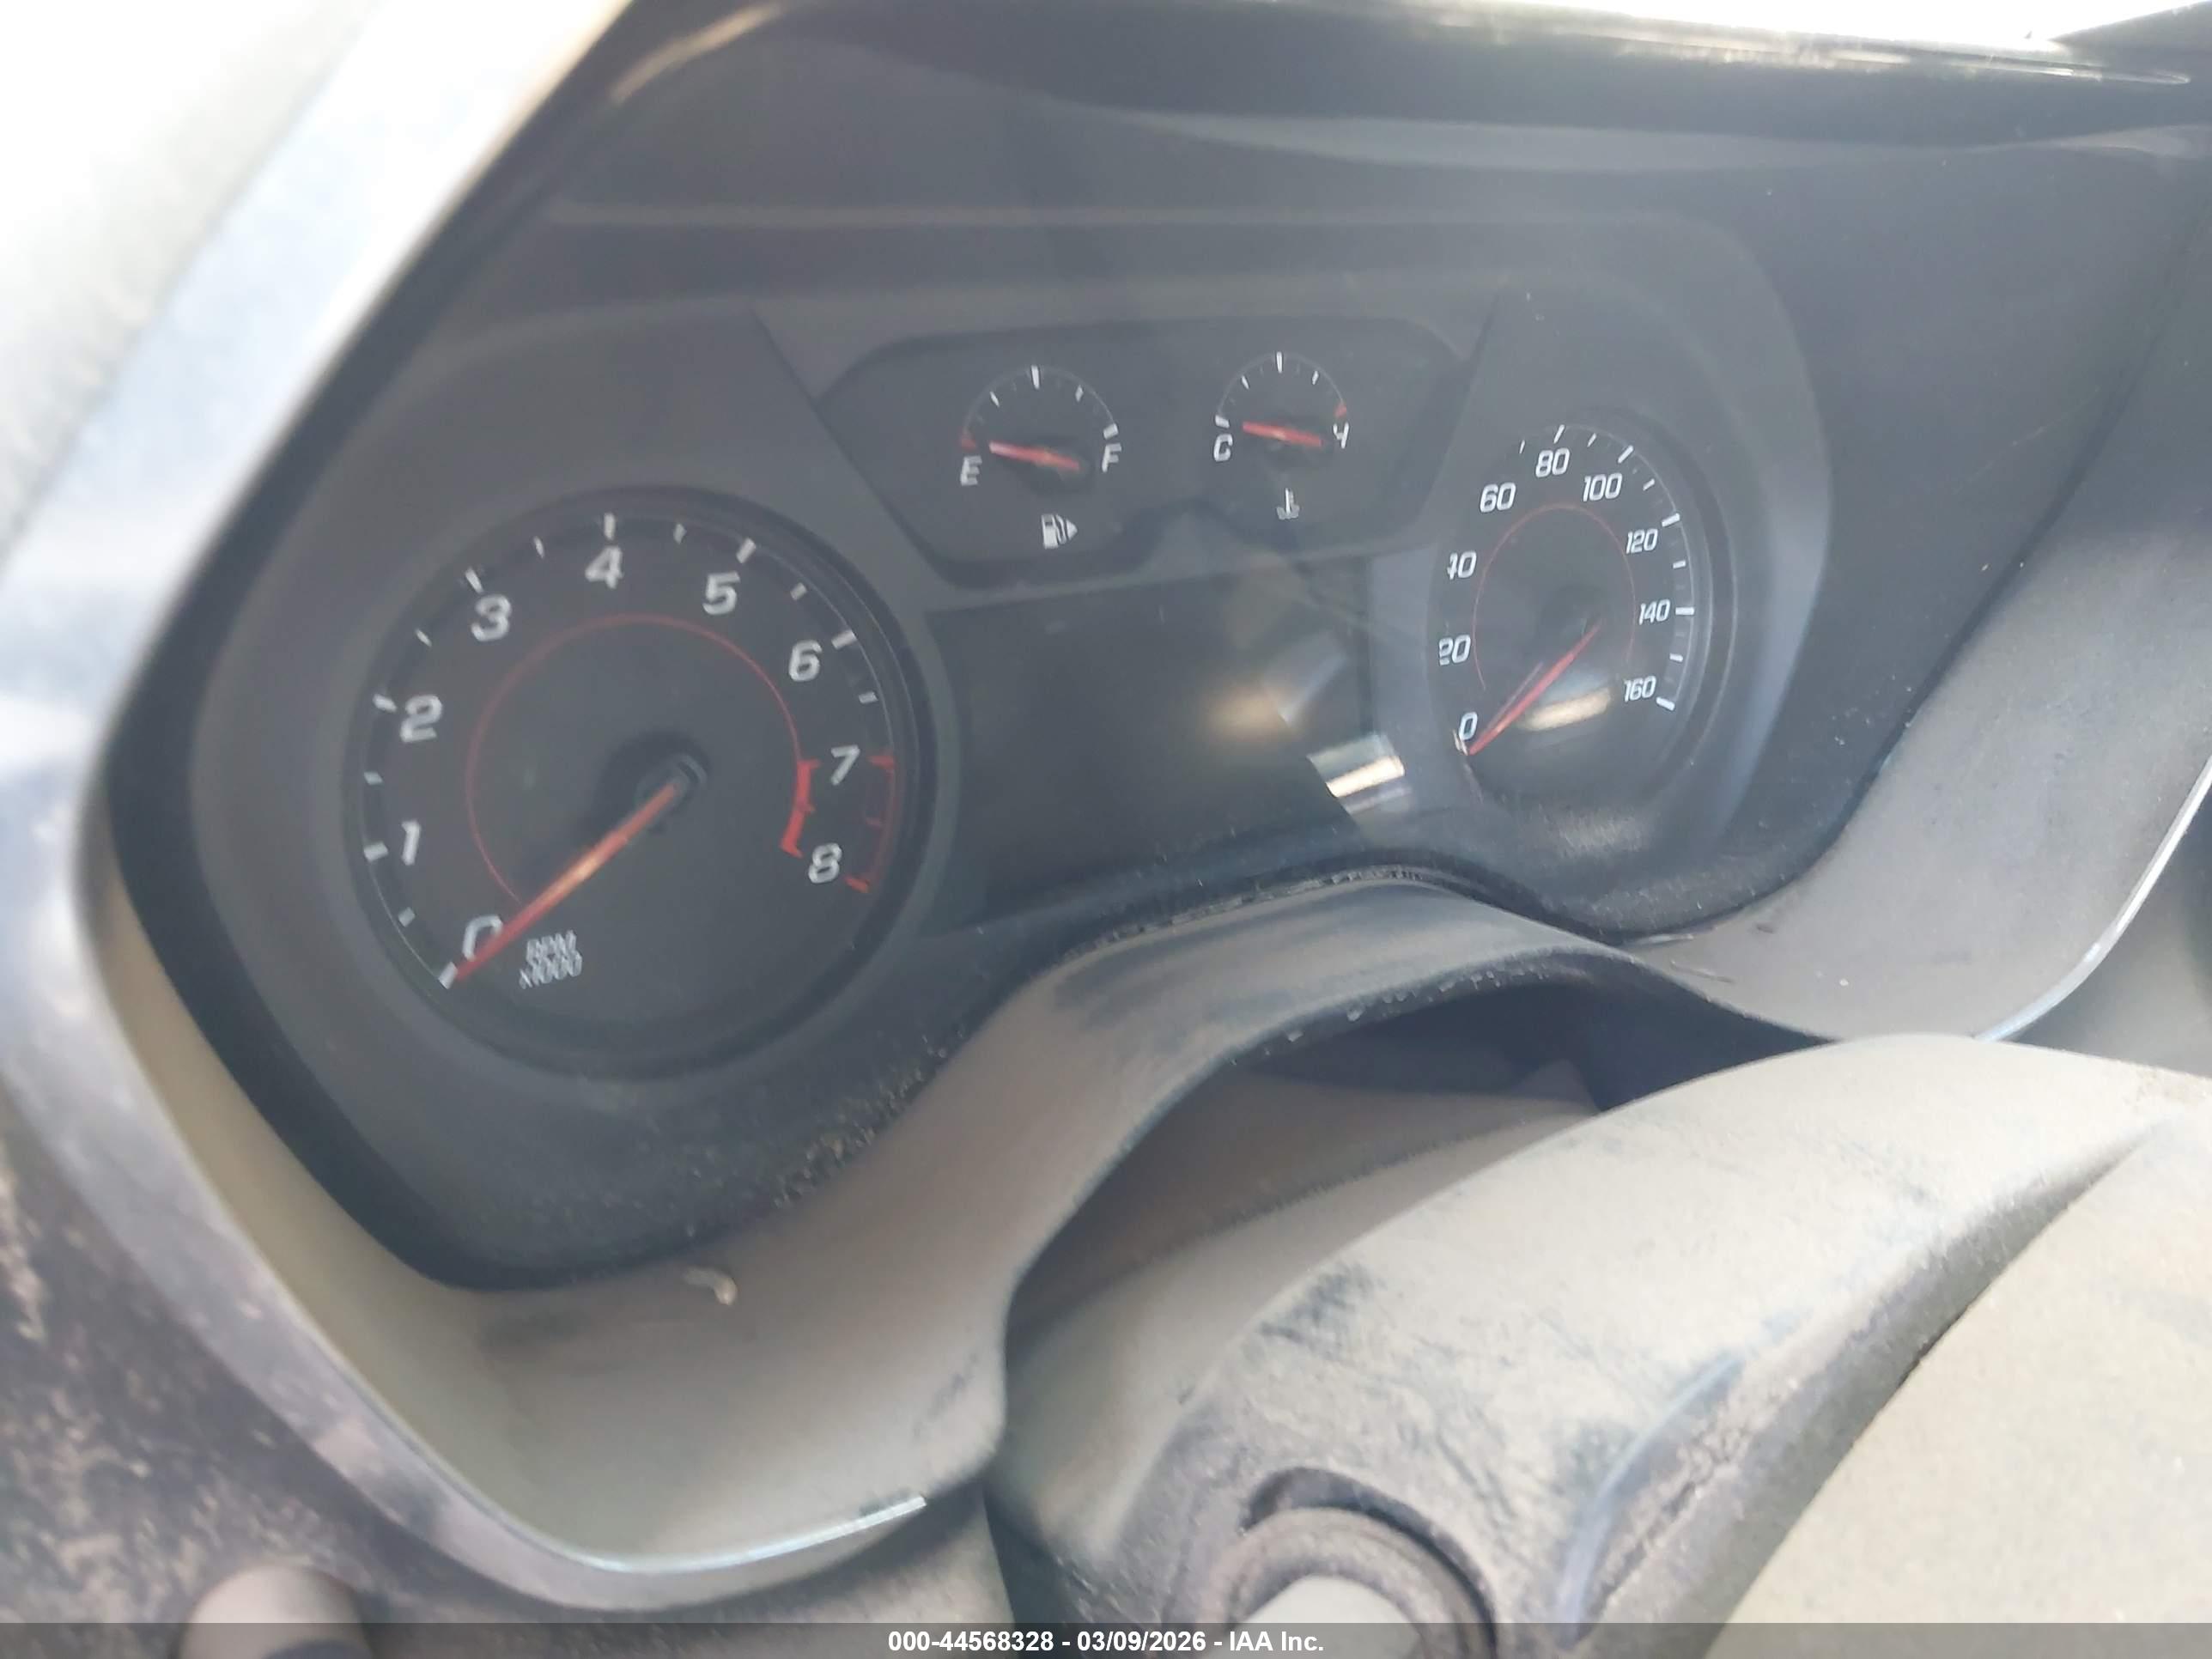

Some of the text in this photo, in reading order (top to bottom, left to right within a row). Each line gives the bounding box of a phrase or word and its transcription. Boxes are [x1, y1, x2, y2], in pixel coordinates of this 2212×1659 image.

[1101, 443, 1122, 473] F
[1213, 434, 1233, 462] C
[1535, 447, 1571, 477] 80
[960, 456, 982, 487] E
[1480, 483, 1516, 513] 60
[1583, 472, 1623, 502] 100
[1626, 528, 1658, 554] 120
[585, 546, 623, 589] 4
[702, 572, 741, 616] 5
[471, 590, 513, 642] 3
[1638, 599, 1671, 625] 140
[788, 641, 823, 683] 6
[1624, 675, 1660, 703] 160
[399, 694, 443, 744] 2
[1459, 711, 1478, 741] 0
[830, 744, 861, 786] 7
[401, 820, 422, 866] 1
[808, 843, 843, 884] 8
